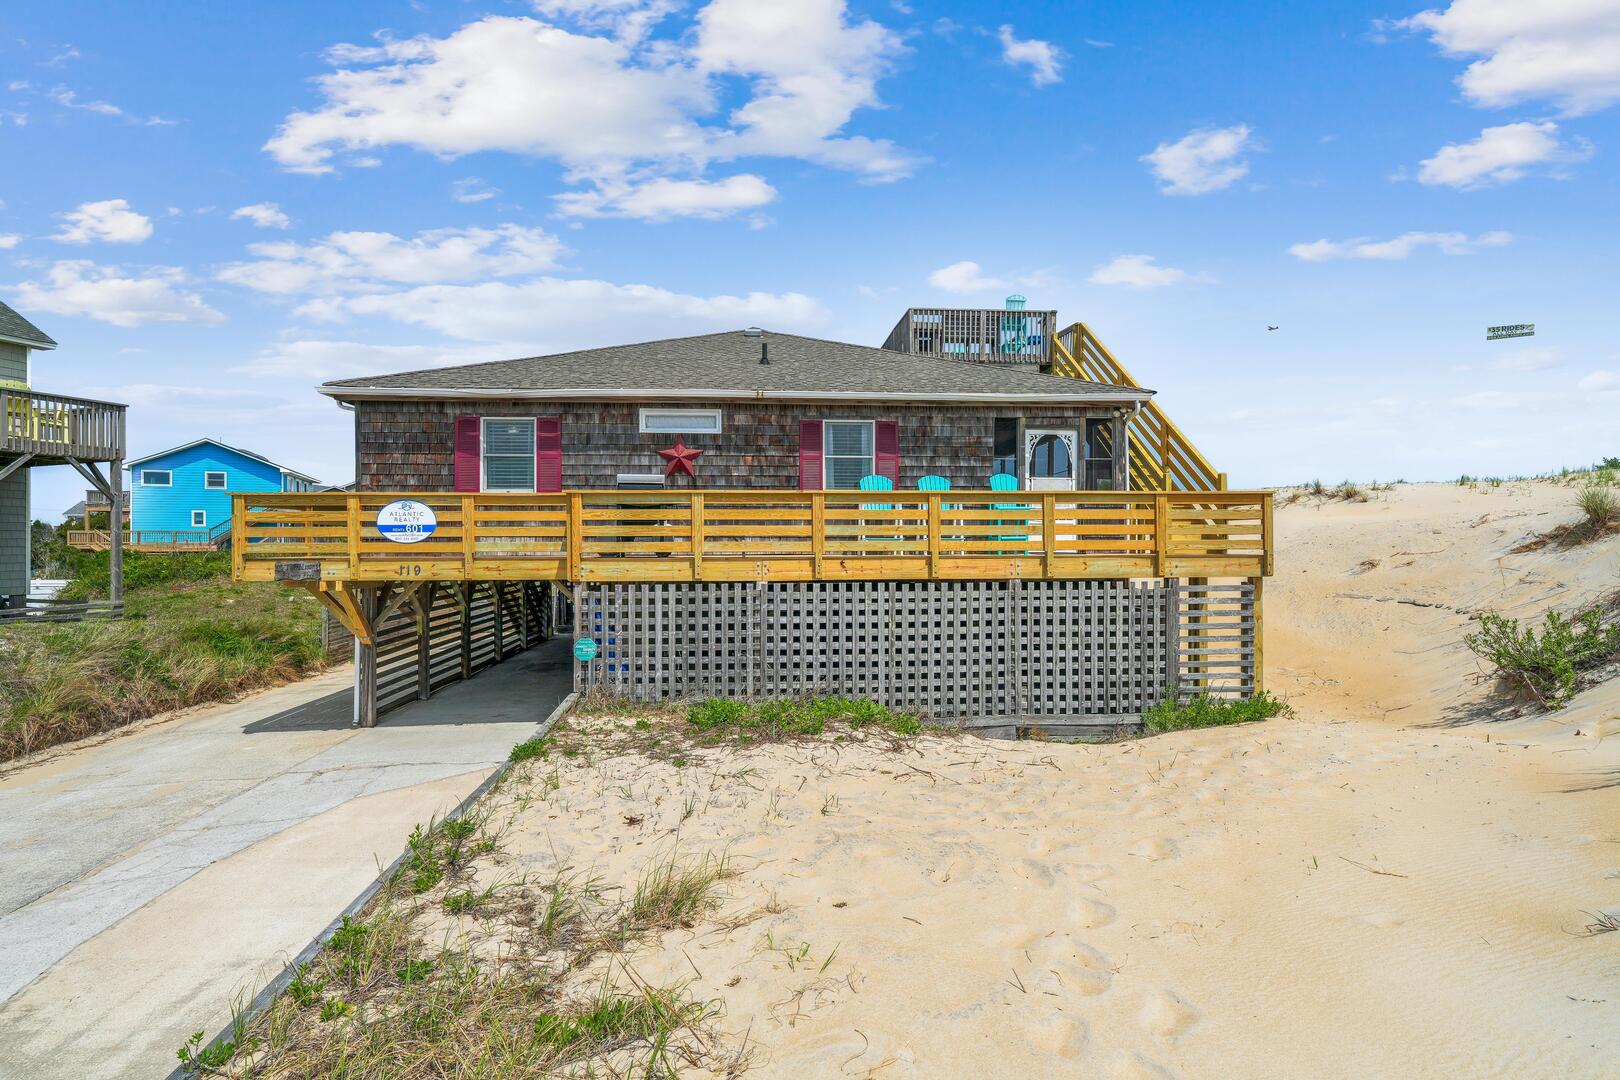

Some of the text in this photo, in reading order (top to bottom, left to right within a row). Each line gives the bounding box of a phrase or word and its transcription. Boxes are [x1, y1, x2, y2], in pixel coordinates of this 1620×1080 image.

[1502, 324, 1525, 332] RIDES
[405, 524, 423, 533] 601
[399, 564, 421, 576] 119
